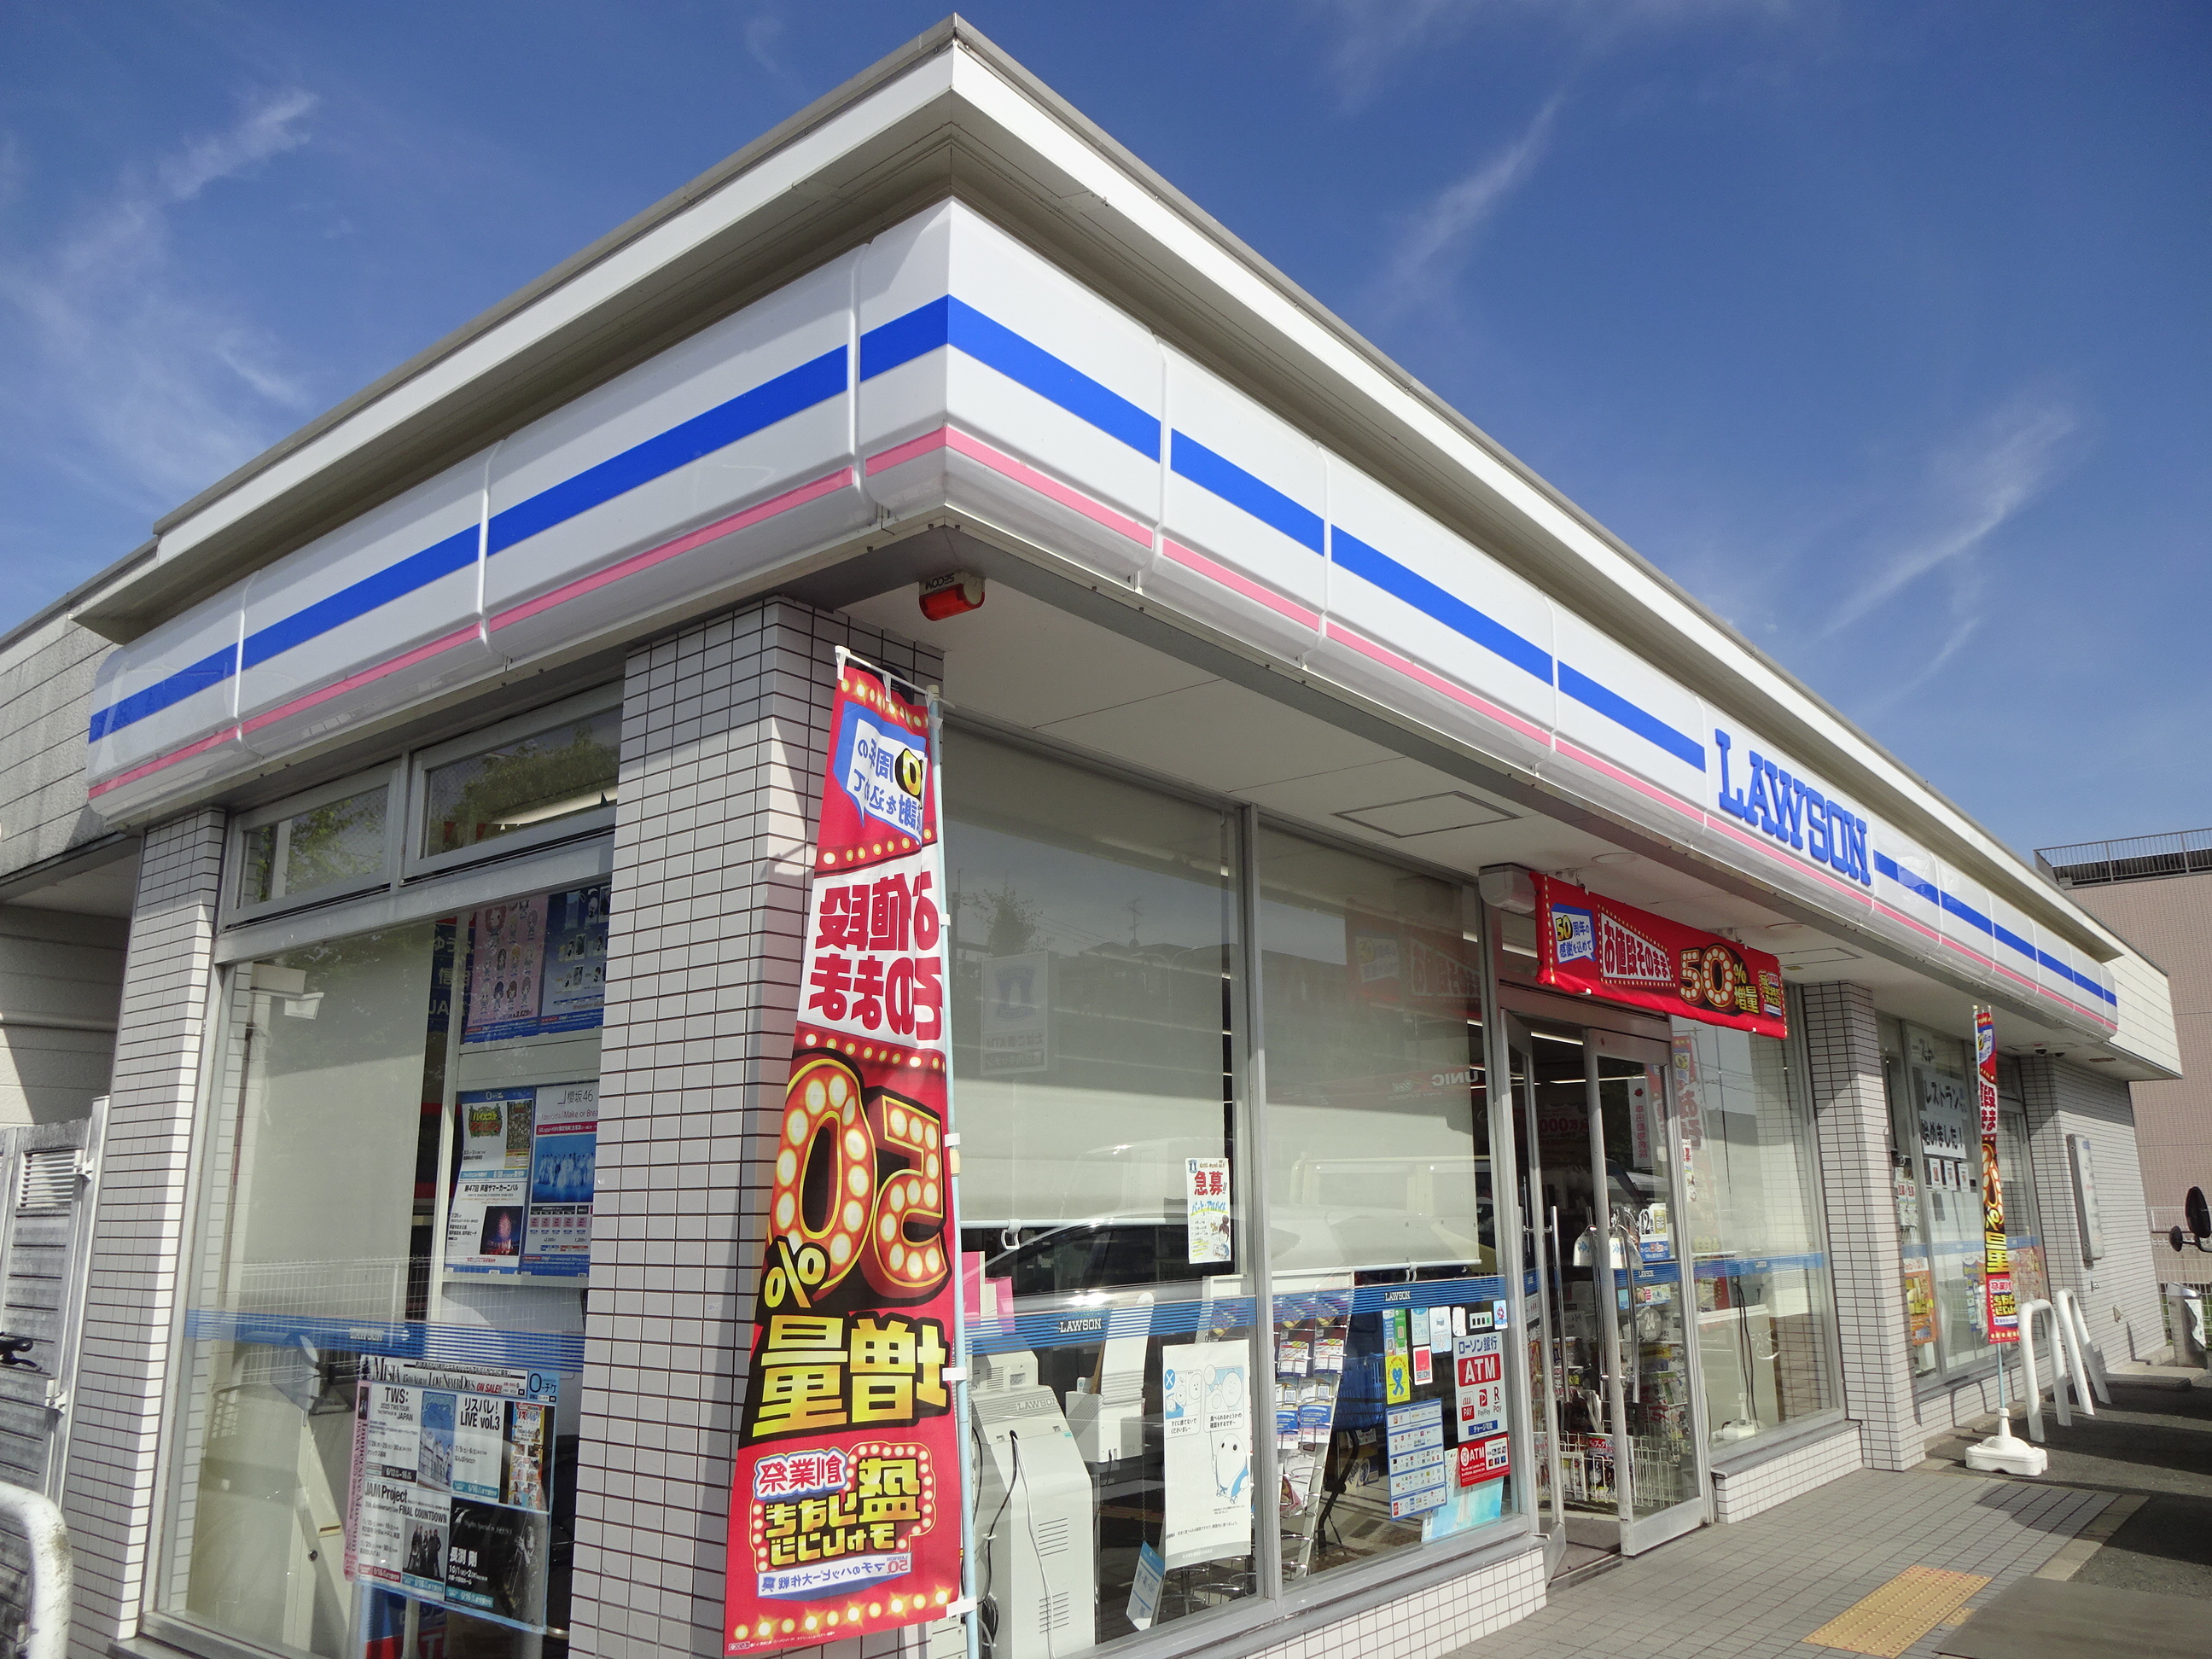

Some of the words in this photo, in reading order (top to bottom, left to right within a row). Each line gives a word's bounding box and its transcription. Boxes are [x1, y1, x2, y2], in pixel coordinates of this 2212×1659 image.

[926, 573, 955, 591] SECOM
[1715, 728, 1871, 886] LAWSON
[1733, 985, 1760, 1015] 増量
[1384, 1290, 1411, 1302] LAWSON
[1059, 1318, 1102, 1333] LAWSON
[1458, 1336, 1498, 1355] ローソン銀行
[1464, 1357, 1497, 1384] ATM
[476, 1382, 484, 1392] ON
[1017, 1397, 1058, 1411] LAWSON
[1463, 1407, 1473, 1417] PAY
[1477, 1408, 1491, 1417] PayPay
[461, 1411, 478, 1428] LIVE
[480, 1416, 501, 1431] vol.3
[1470, 1446, 1485, 1462] ATM
[381, 1485, 409, 1505] Project
